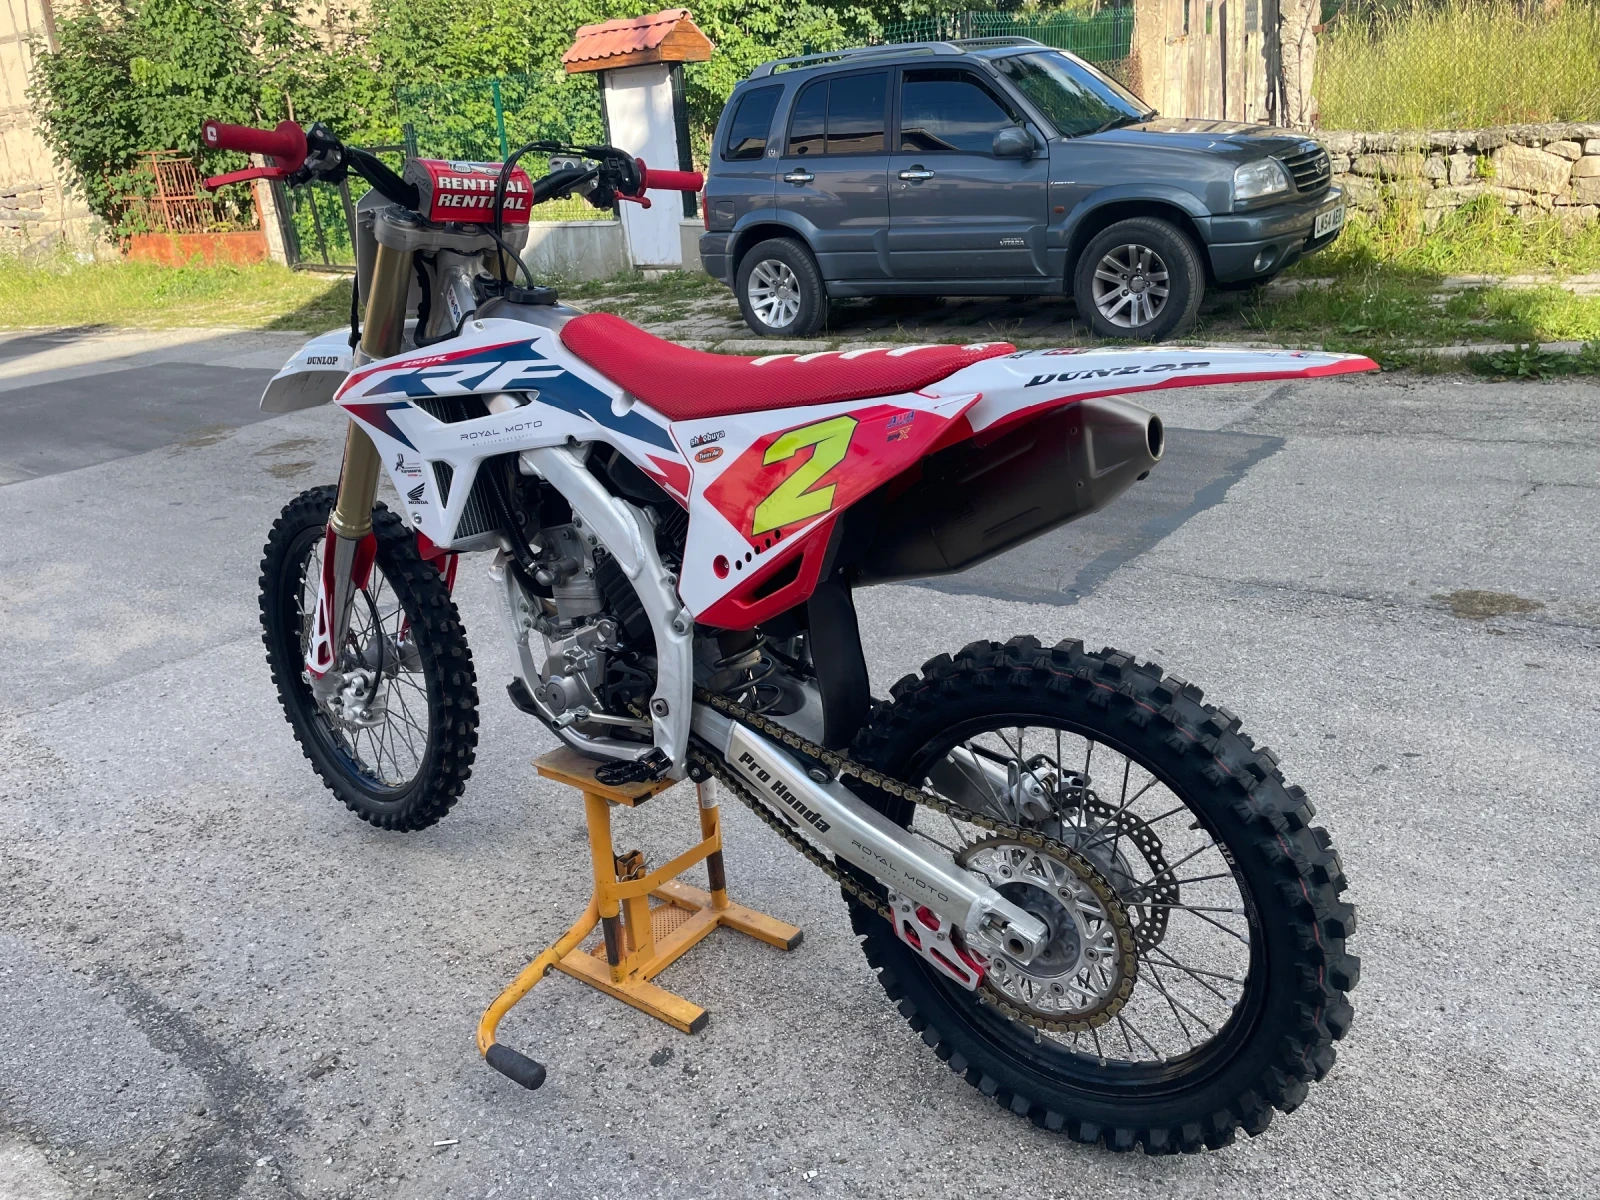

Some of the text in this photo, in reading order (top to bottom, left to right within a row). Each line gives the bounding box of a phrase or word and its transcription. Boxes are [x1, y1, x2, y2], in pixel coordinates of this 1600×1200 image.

[306, 356, 339, 365] DUNLOP
[401, 355, 447, 367] 250R
[1024, 361, 1211, 388] DUNLOP
[460, 429, 500, 440] ROYAL
[505, 420, 543, 433] MOTO
[699, 451, 712, 460] Twin
[752, 415, 859, 536] 2
[738, 751, 831, 834] Pro Honda
[851, 839, 897, 872] ROYAL
[904, 872, 949, 902] MOTO
